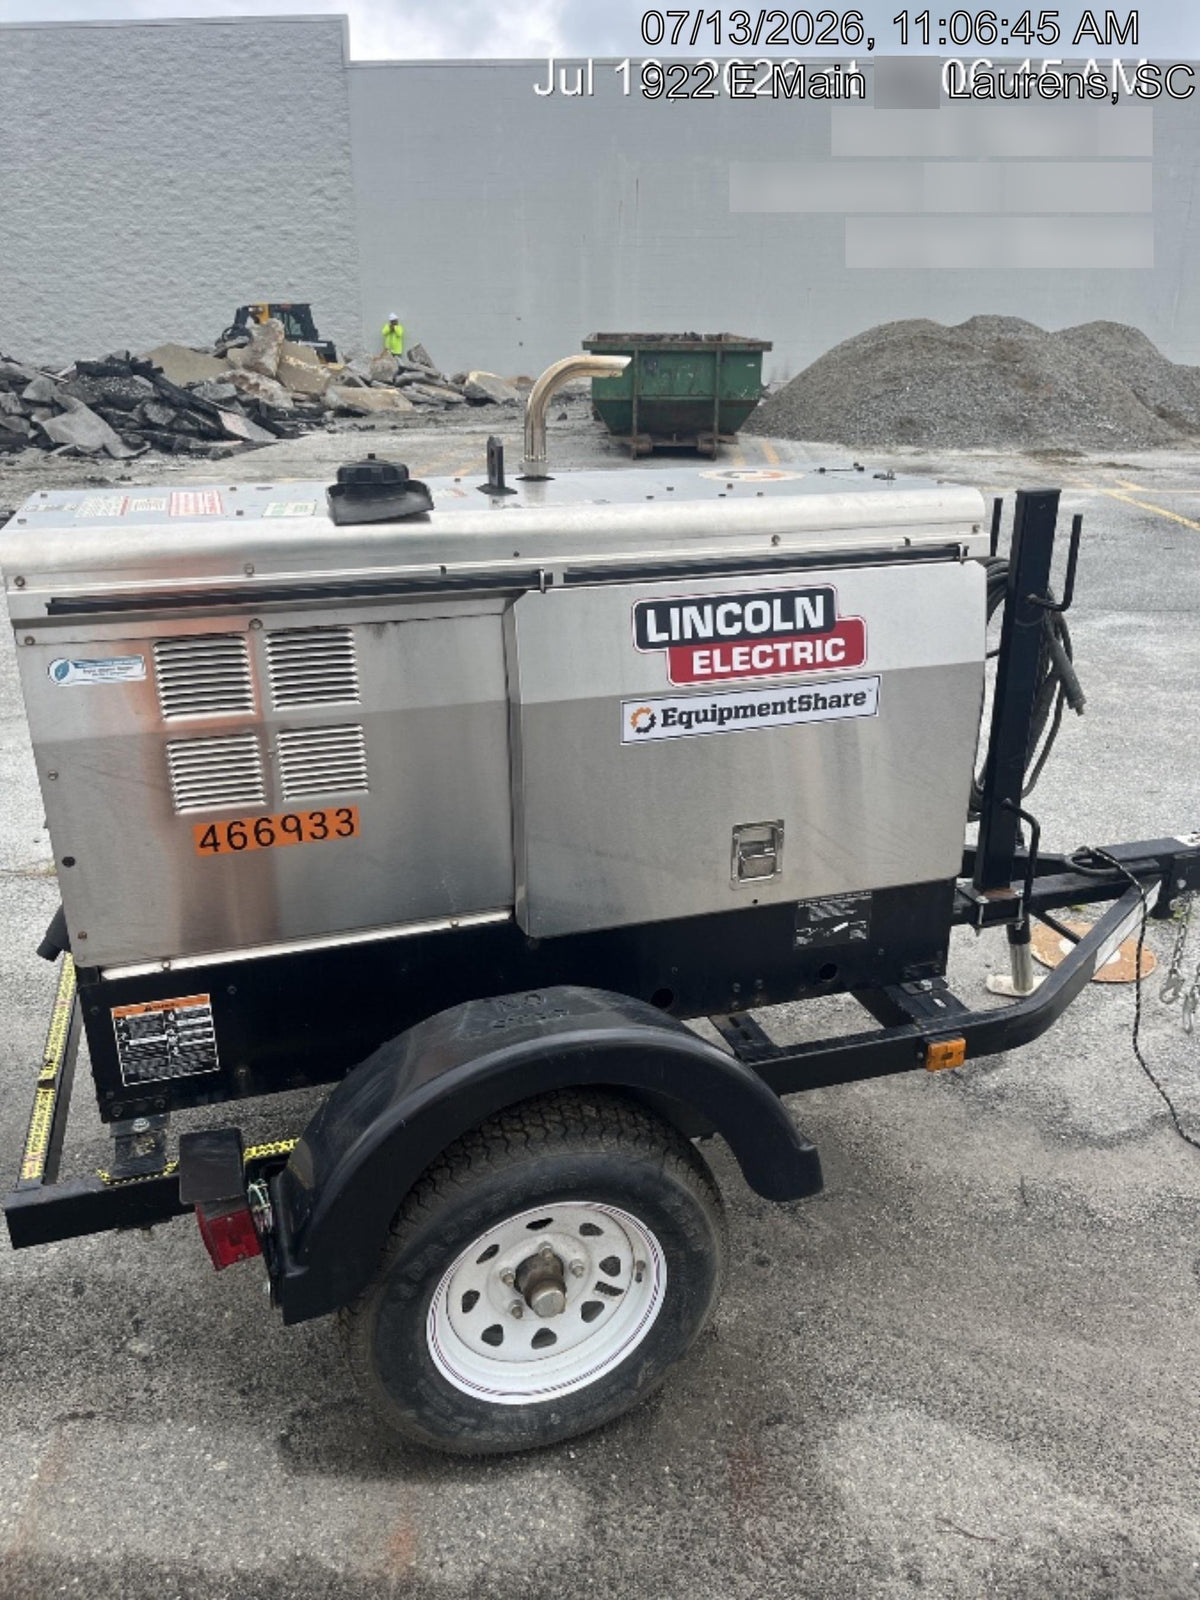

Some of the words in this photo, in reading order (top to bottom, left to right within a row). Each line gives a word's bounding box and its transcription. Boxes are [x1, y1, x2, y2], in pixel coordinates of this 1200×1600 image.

[646, 595, 824, 642] LINCOLN
[692, 637, 845, 676] ELECTRIC
[661, 689, 866, 730] EquipmentShare
[199, 808, 355, 852] 466933
